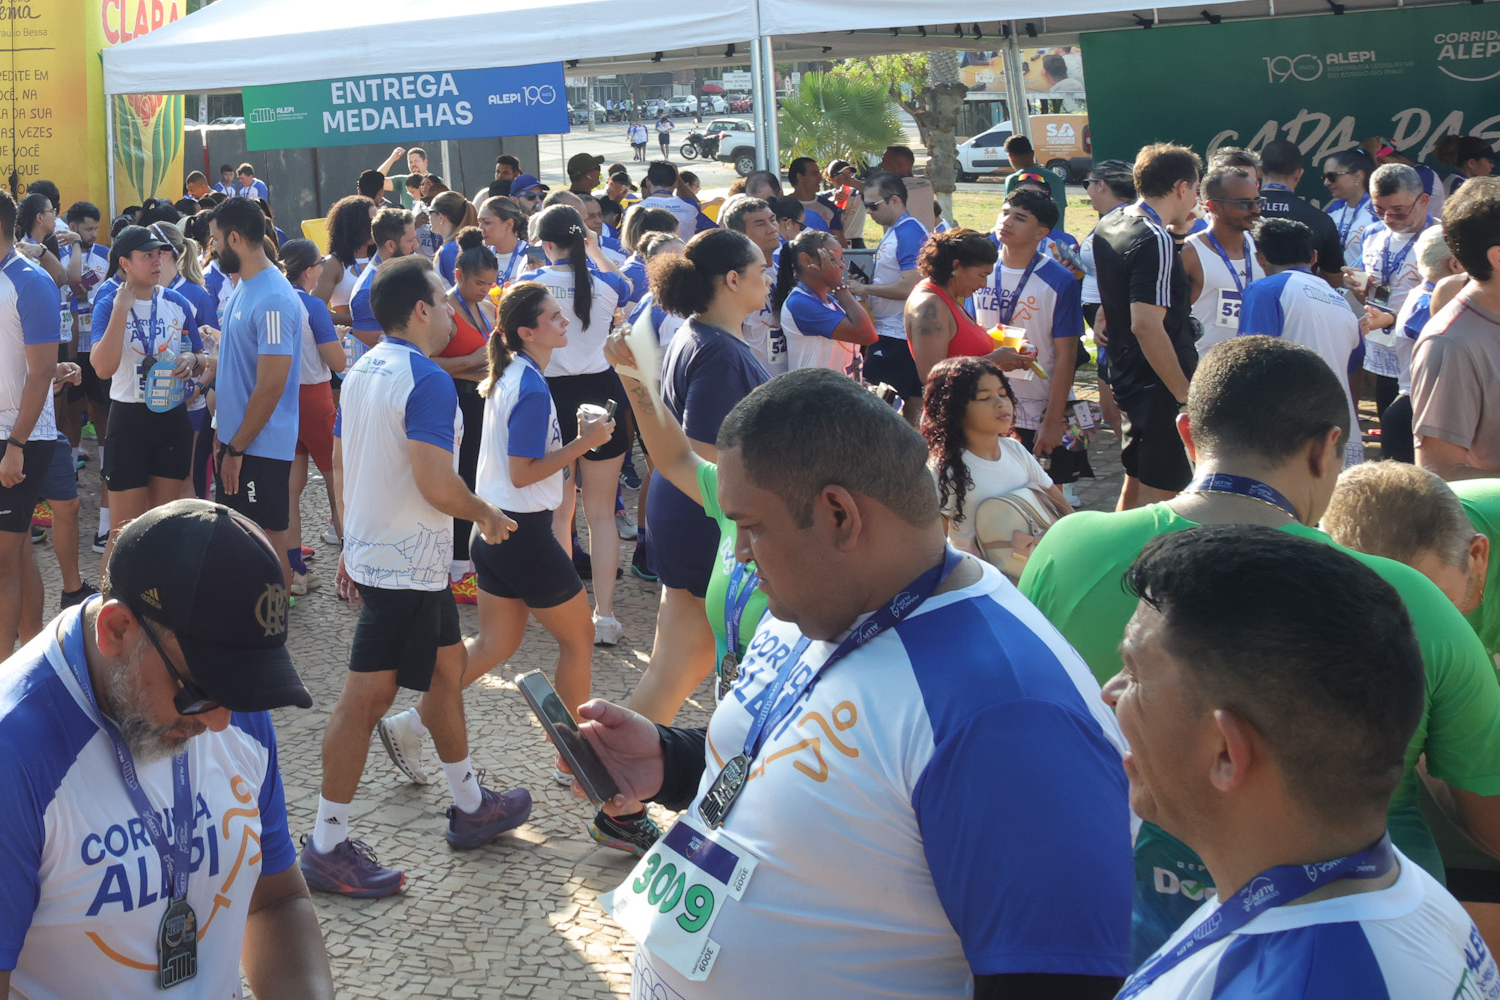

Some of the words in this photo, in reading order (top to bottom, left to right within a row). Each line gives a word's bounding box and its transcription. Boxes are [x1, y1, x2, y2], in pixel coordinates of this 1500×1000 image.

[23, 28, 48, 37] Bessa
[1434, 30, 1500, 44] CORRID
[1326, 50, 1376, 64] ALEPI
[1437, 41, 1500, 61] ALEP
[34, 69, 49, 81] EM
[1262, 53, 1323, 84] 190
[22, 89, 38, 100] NA
[330, 73, 460, 105] ENTREGA
[522, 84, 557, 107] 190
[488, 93, 522, 105] ALEPI
[13, 108, 26, 119] DA
[30, 107, 53, 119] SUA
[276, 106, 295, 114] ALEPI
[322, 101, 474, 133] MEDALHAS
[19, 127, 53, 138] VEZES
[1046, 122, 1075, 137] SA
[13, 143, 40, 158] VOCÊ
[17, 164, 40, 176] QUE
[1260, 202, 1290, 212] TLETA
[246, 480, 257, 503] FILA
[863, 622, 879, 640] ALEPI
[178, 766, 186, 786] ALEPI
[735, 867, 749, 892] 3009
[632, 852, 715, 934] 3009
[698, 947, 714, 972] 3009
